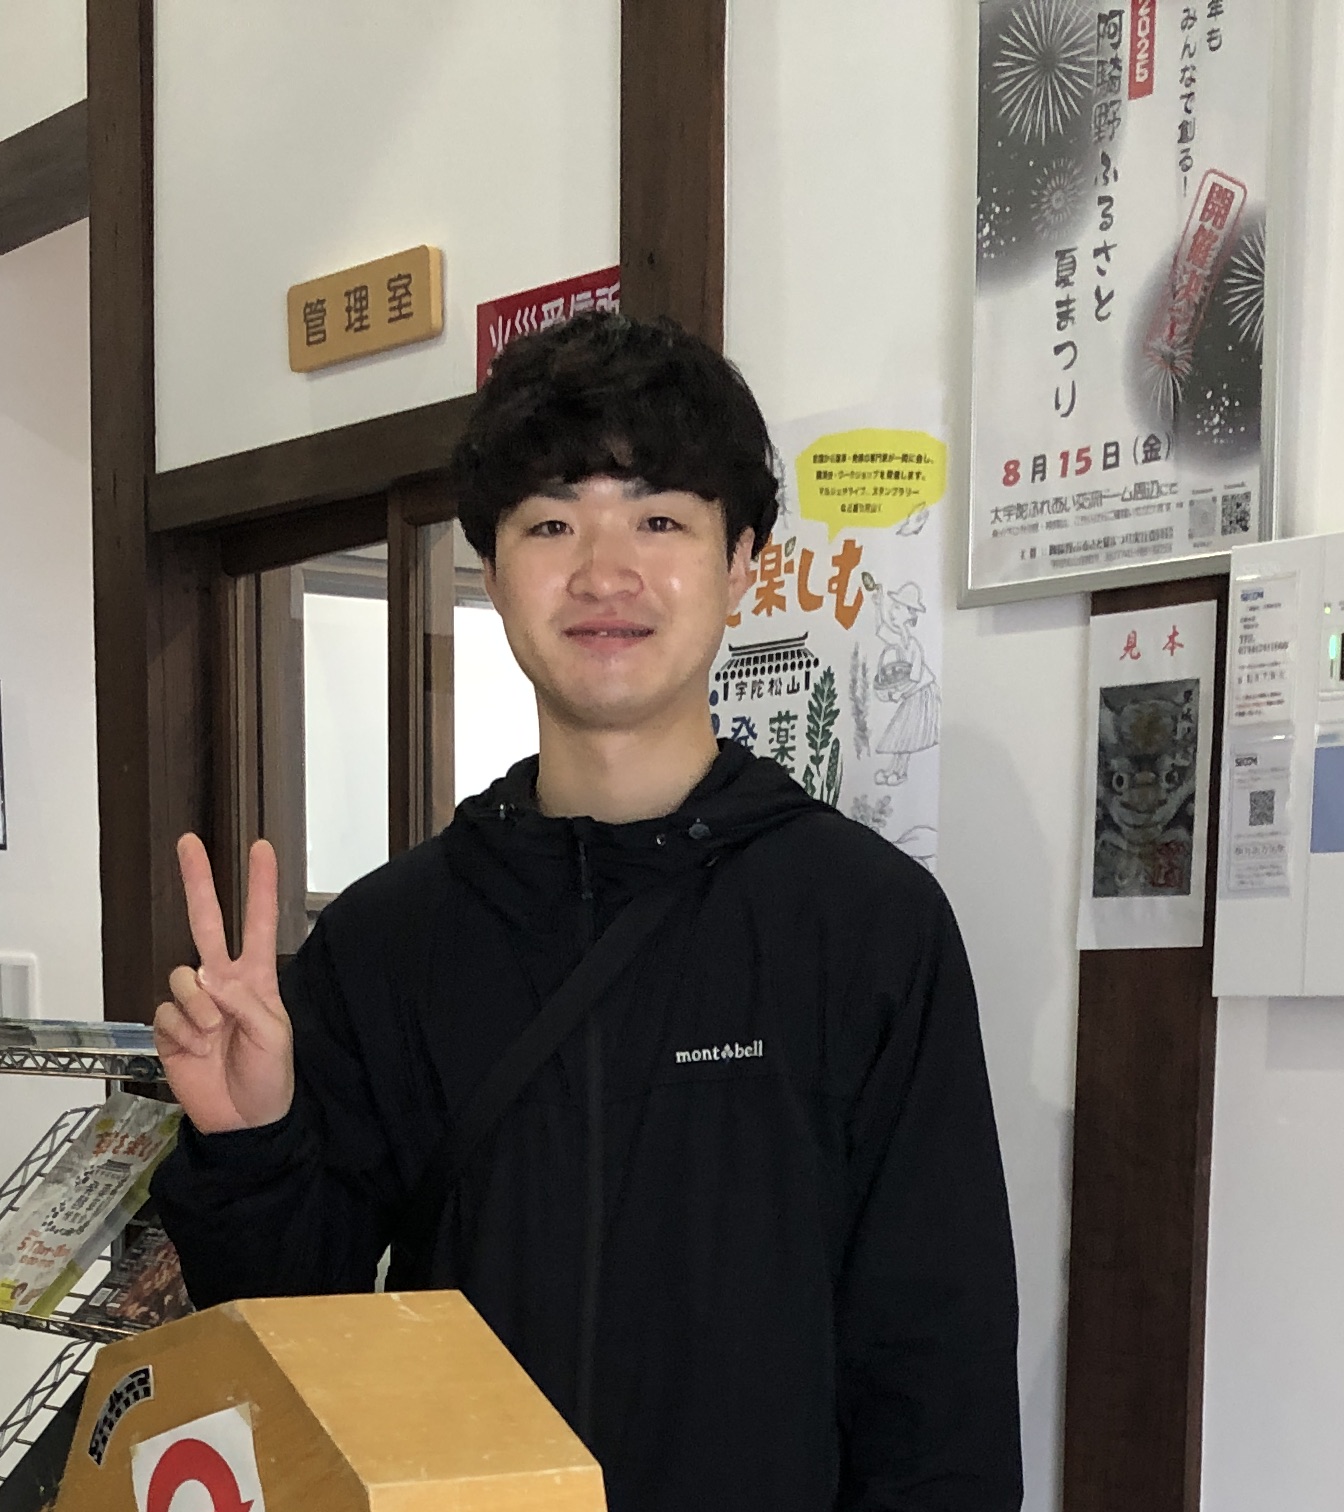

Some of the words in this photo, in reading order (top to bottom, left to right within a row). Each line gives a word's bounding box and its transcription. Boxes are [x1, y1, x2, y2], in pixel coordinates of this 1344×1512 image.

[1135, 0, 1152, 83] 2025
[302, 272, 414, 347] 管理室
[1053, 247, 1079, 418] 夏まつり
[1002, 433, 1173, 487] 8月15日(金)
[1119, 625, 1185, 661] 見本
[735, 674, 801, 701] 宇陀松山
